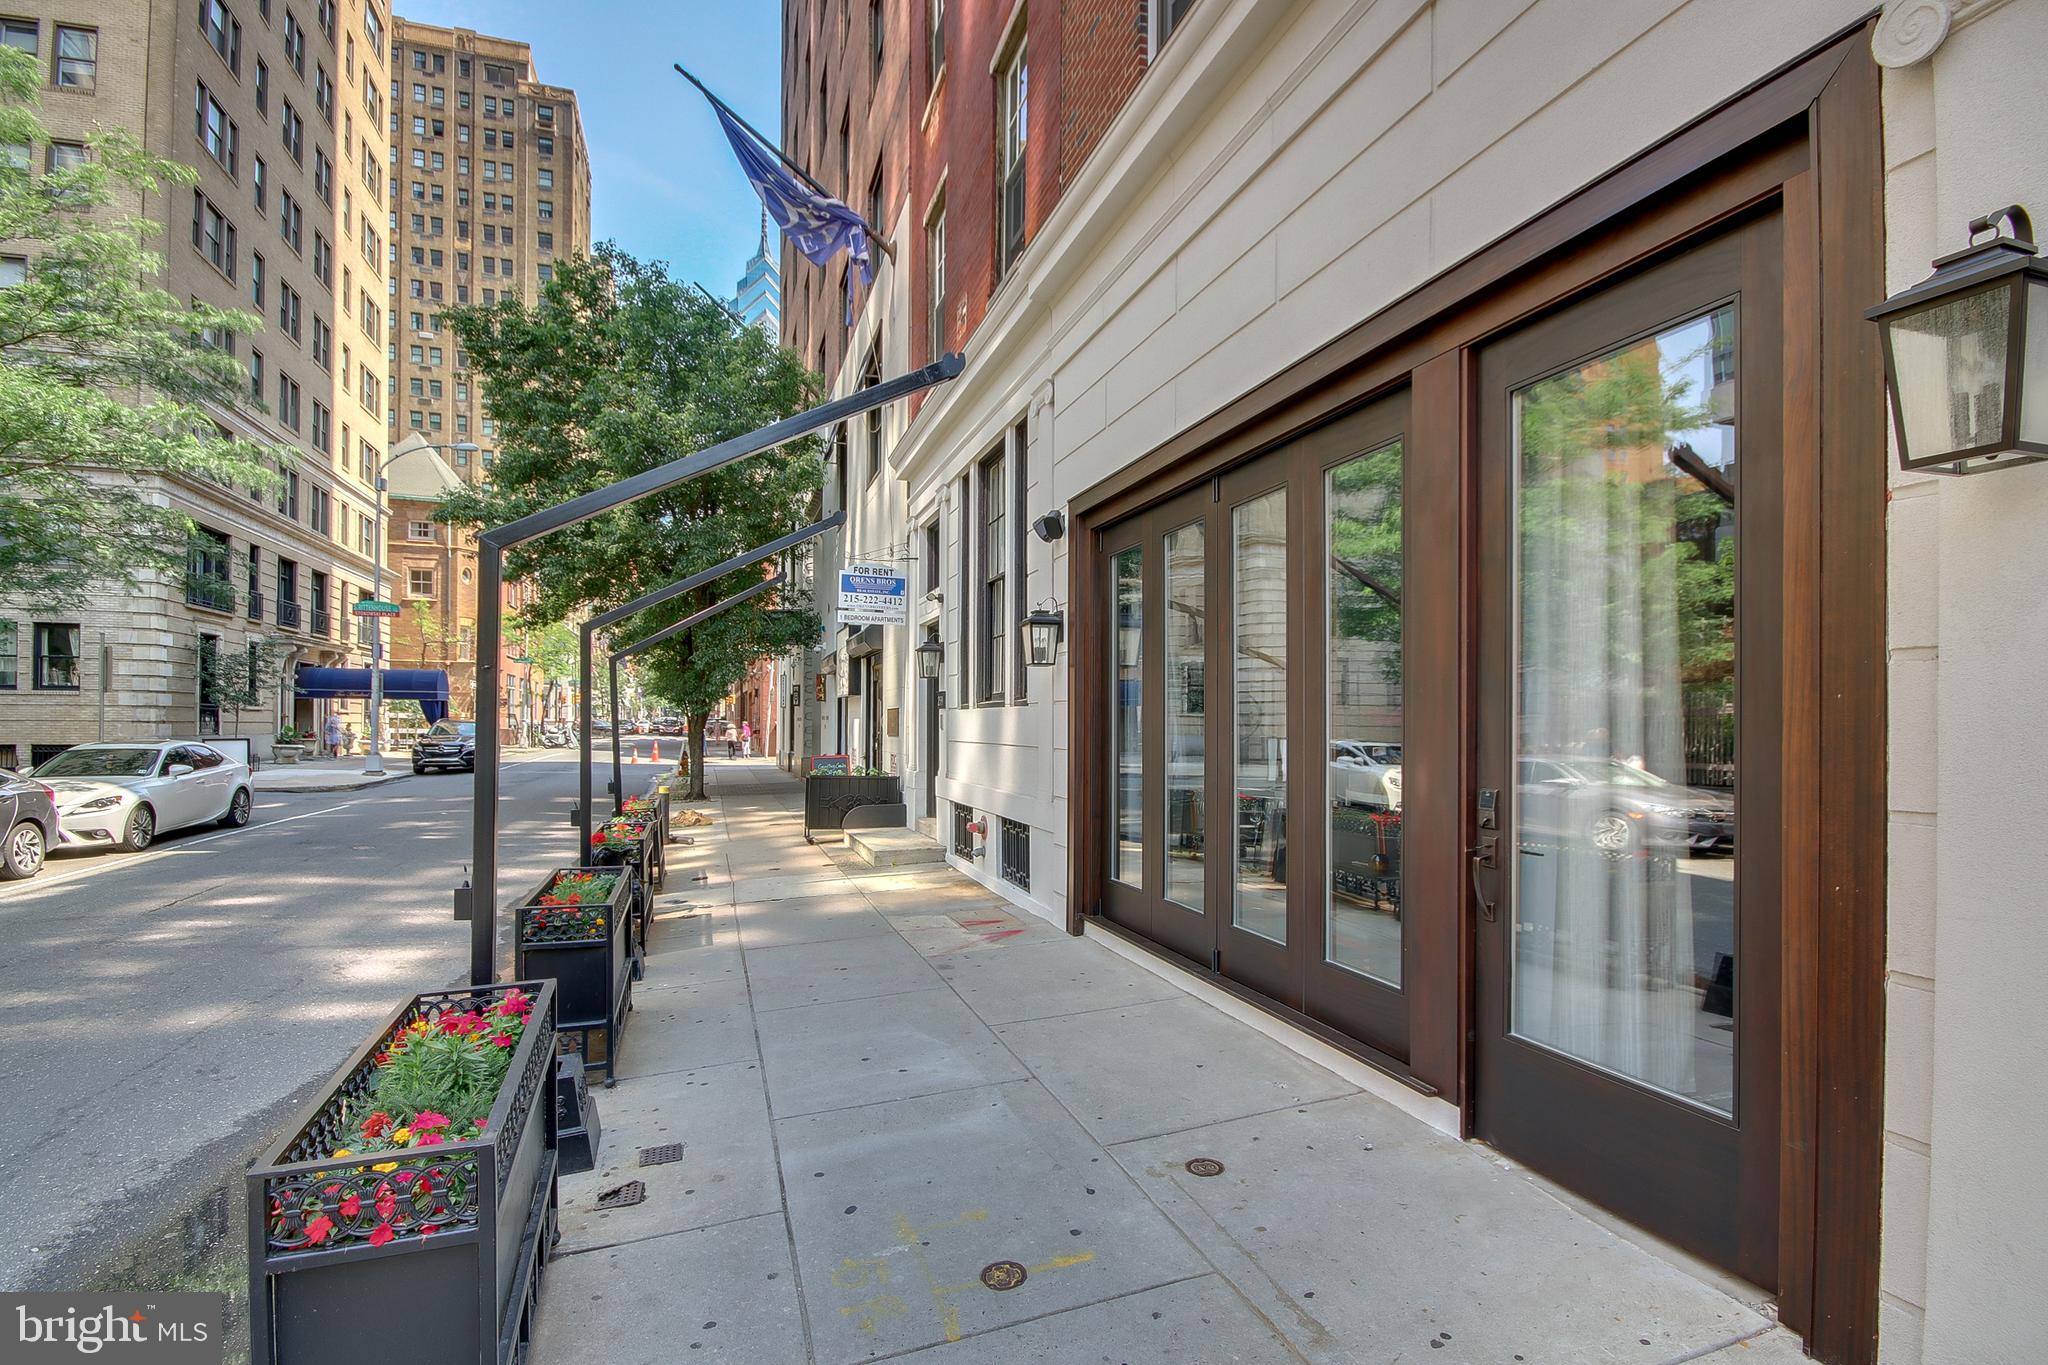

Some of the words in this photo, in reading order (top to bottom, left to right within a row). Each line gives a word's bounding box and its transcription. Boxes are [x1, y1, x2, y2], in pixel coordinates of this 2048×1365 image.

[853, 566, 870, 575] FOR
[872, 568, 894, 576] RENT
[849, 576, 875, 585] ORENS
[876, 577, 896, 585] BROS
[843, 594, 903, 606] 215-222-4412
[871, 616, 904, 624] APARTMENTS
